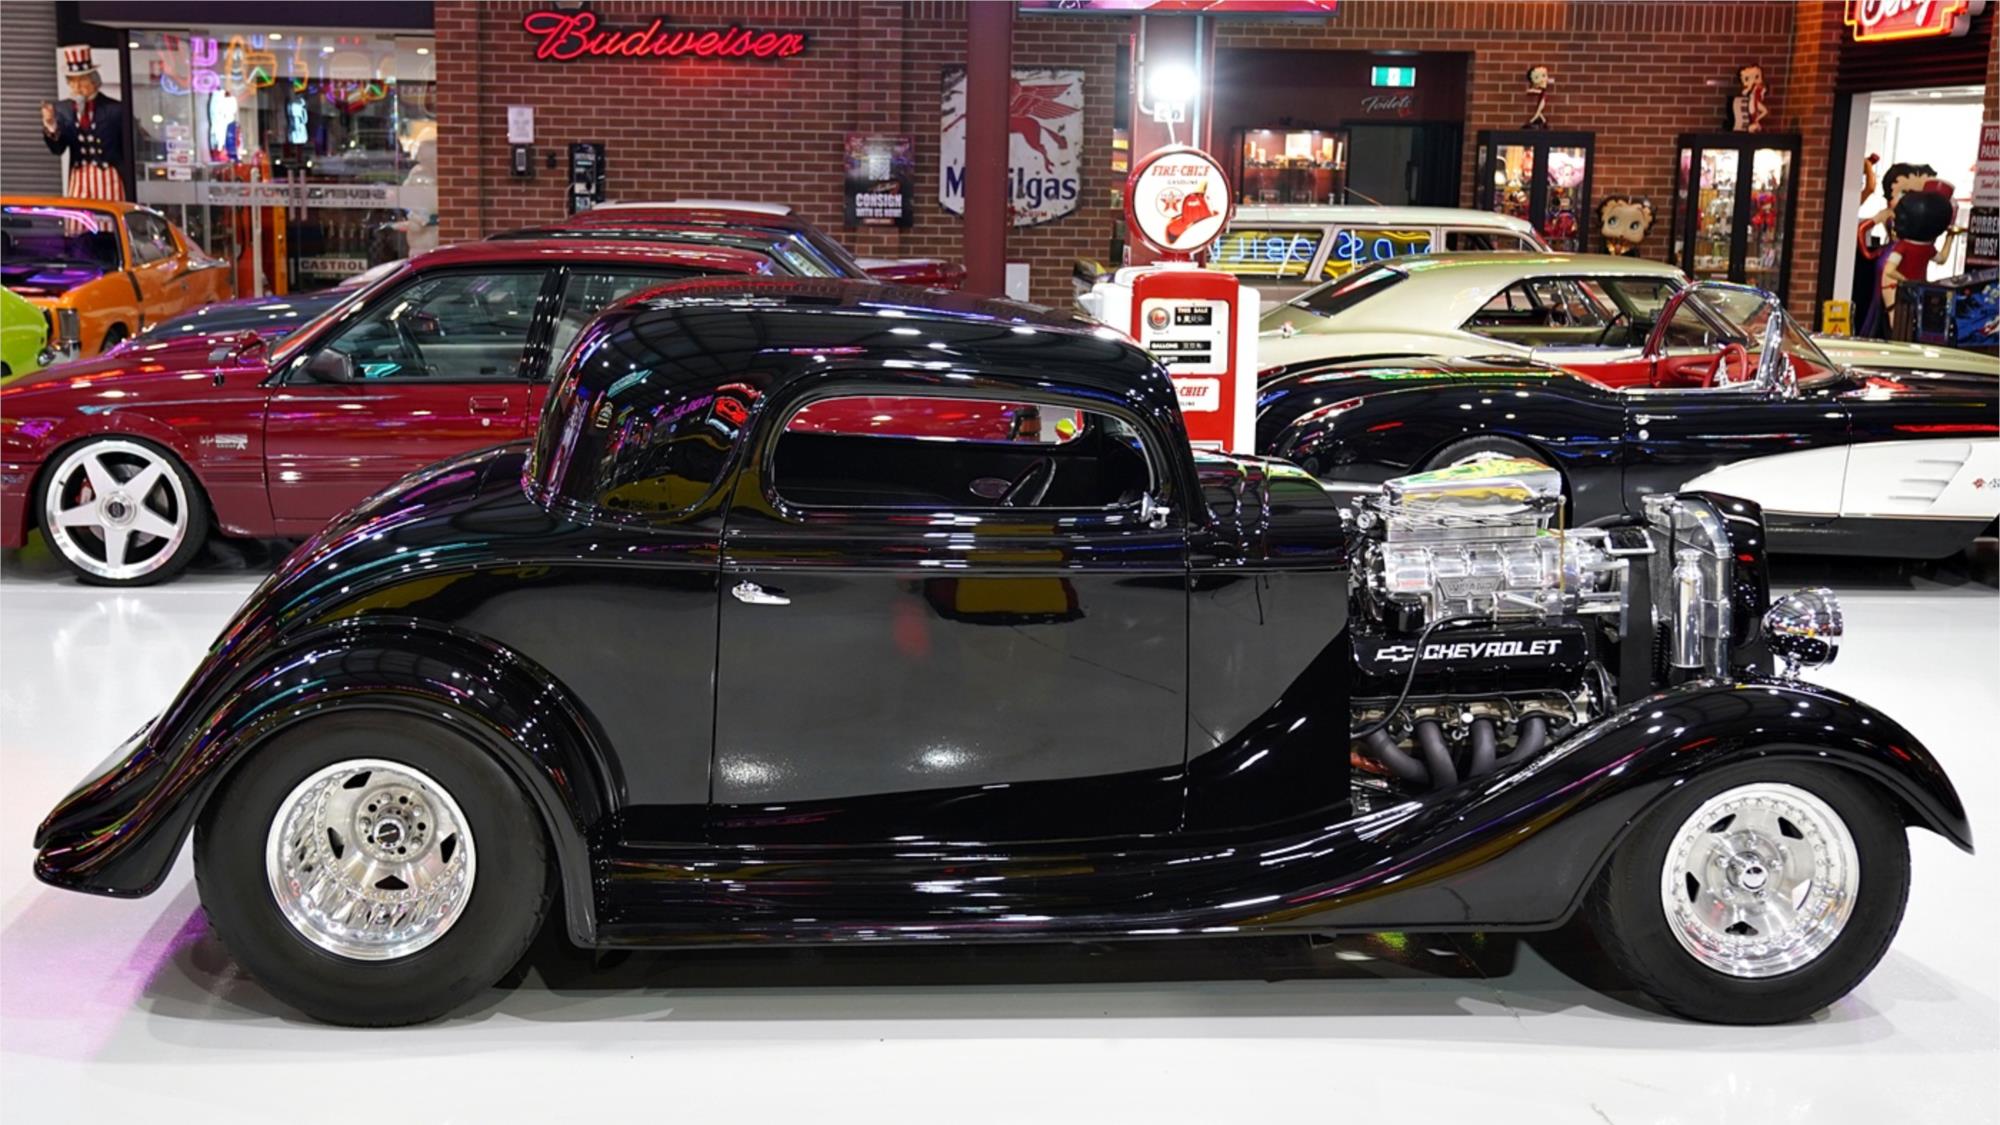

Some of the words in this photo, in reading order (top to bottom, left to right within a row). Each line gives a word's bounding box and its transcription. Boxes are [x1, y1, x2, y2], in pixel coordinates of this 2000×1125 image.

[524, 12, 804, 60] Budweiser
[946, 166, 1076, 209] Milgas
[856, 193, 902, 207] CONSIGN
[301, 261, 365, 271] CASTROL
[1422, 640, 1562, 660] CHEVROLET
